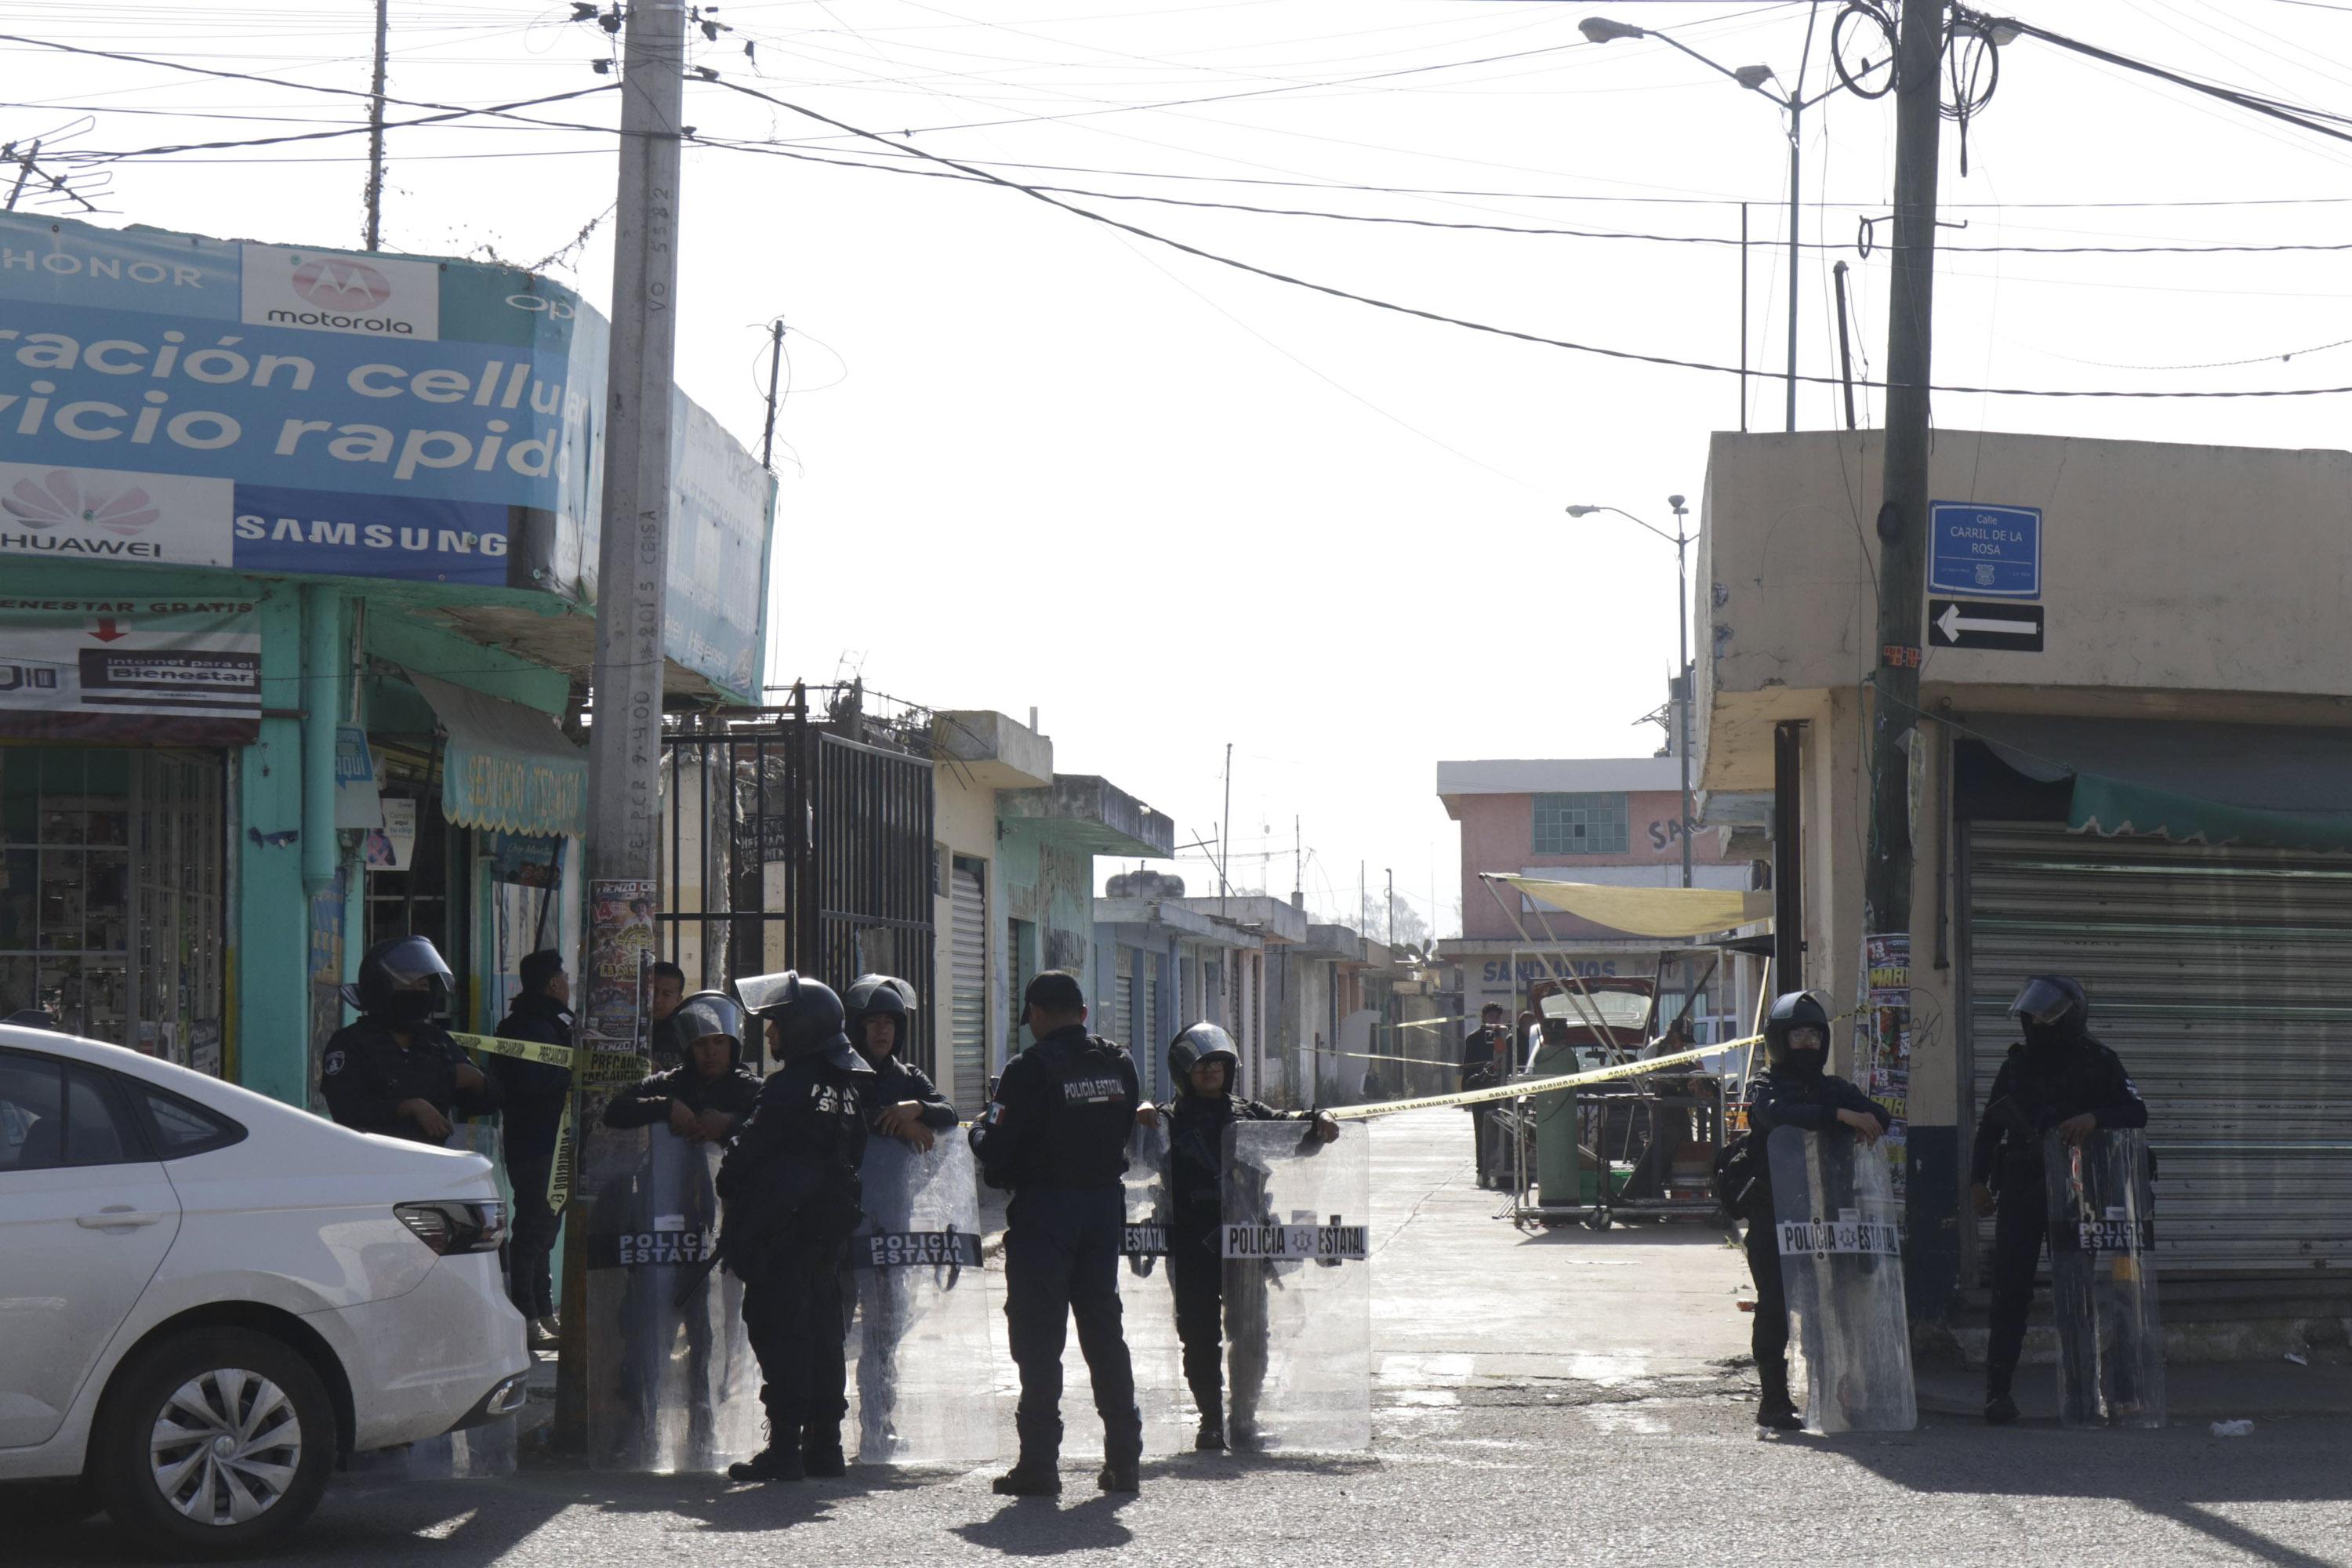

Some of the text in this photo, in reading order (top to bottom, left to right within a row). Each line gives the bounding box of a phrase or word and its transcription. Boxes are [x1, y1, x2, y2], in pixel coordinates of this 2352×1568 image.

[2, 248, 202, 289] HONOR
[268, 309, 412, 335] motorola
[274, 419, 570, 484] rapido
[1976, 514, 1998, 524] Calle
[236, 514, 508, 557] SAMSUNG
[1951, 526, 2023, 542] CARRIL DE LA
[2, 533, 161, 557] HUAWEI
[1972, 543, 2001, 555] ROSA
[150, 602, 252, 614] GRATIS
[191, 660, 234, 669] para
[112, 667, 251, 682] Bienestar
[1095, 1079, 1125, 1095] ESTATAL
[619, 1232, 710, 1249] POLICI
[1125, 1227, 1168, 1253] ESTATAL
[1229, 1226, 1366, 1254] POLICIA ESTATAL
[1785, 1224, 1897, 1253] POLICIA ESTATAL
[619, 1248, 710, 1264] ESTATA
[872, 1249, 964, 1265] ESTATAL
